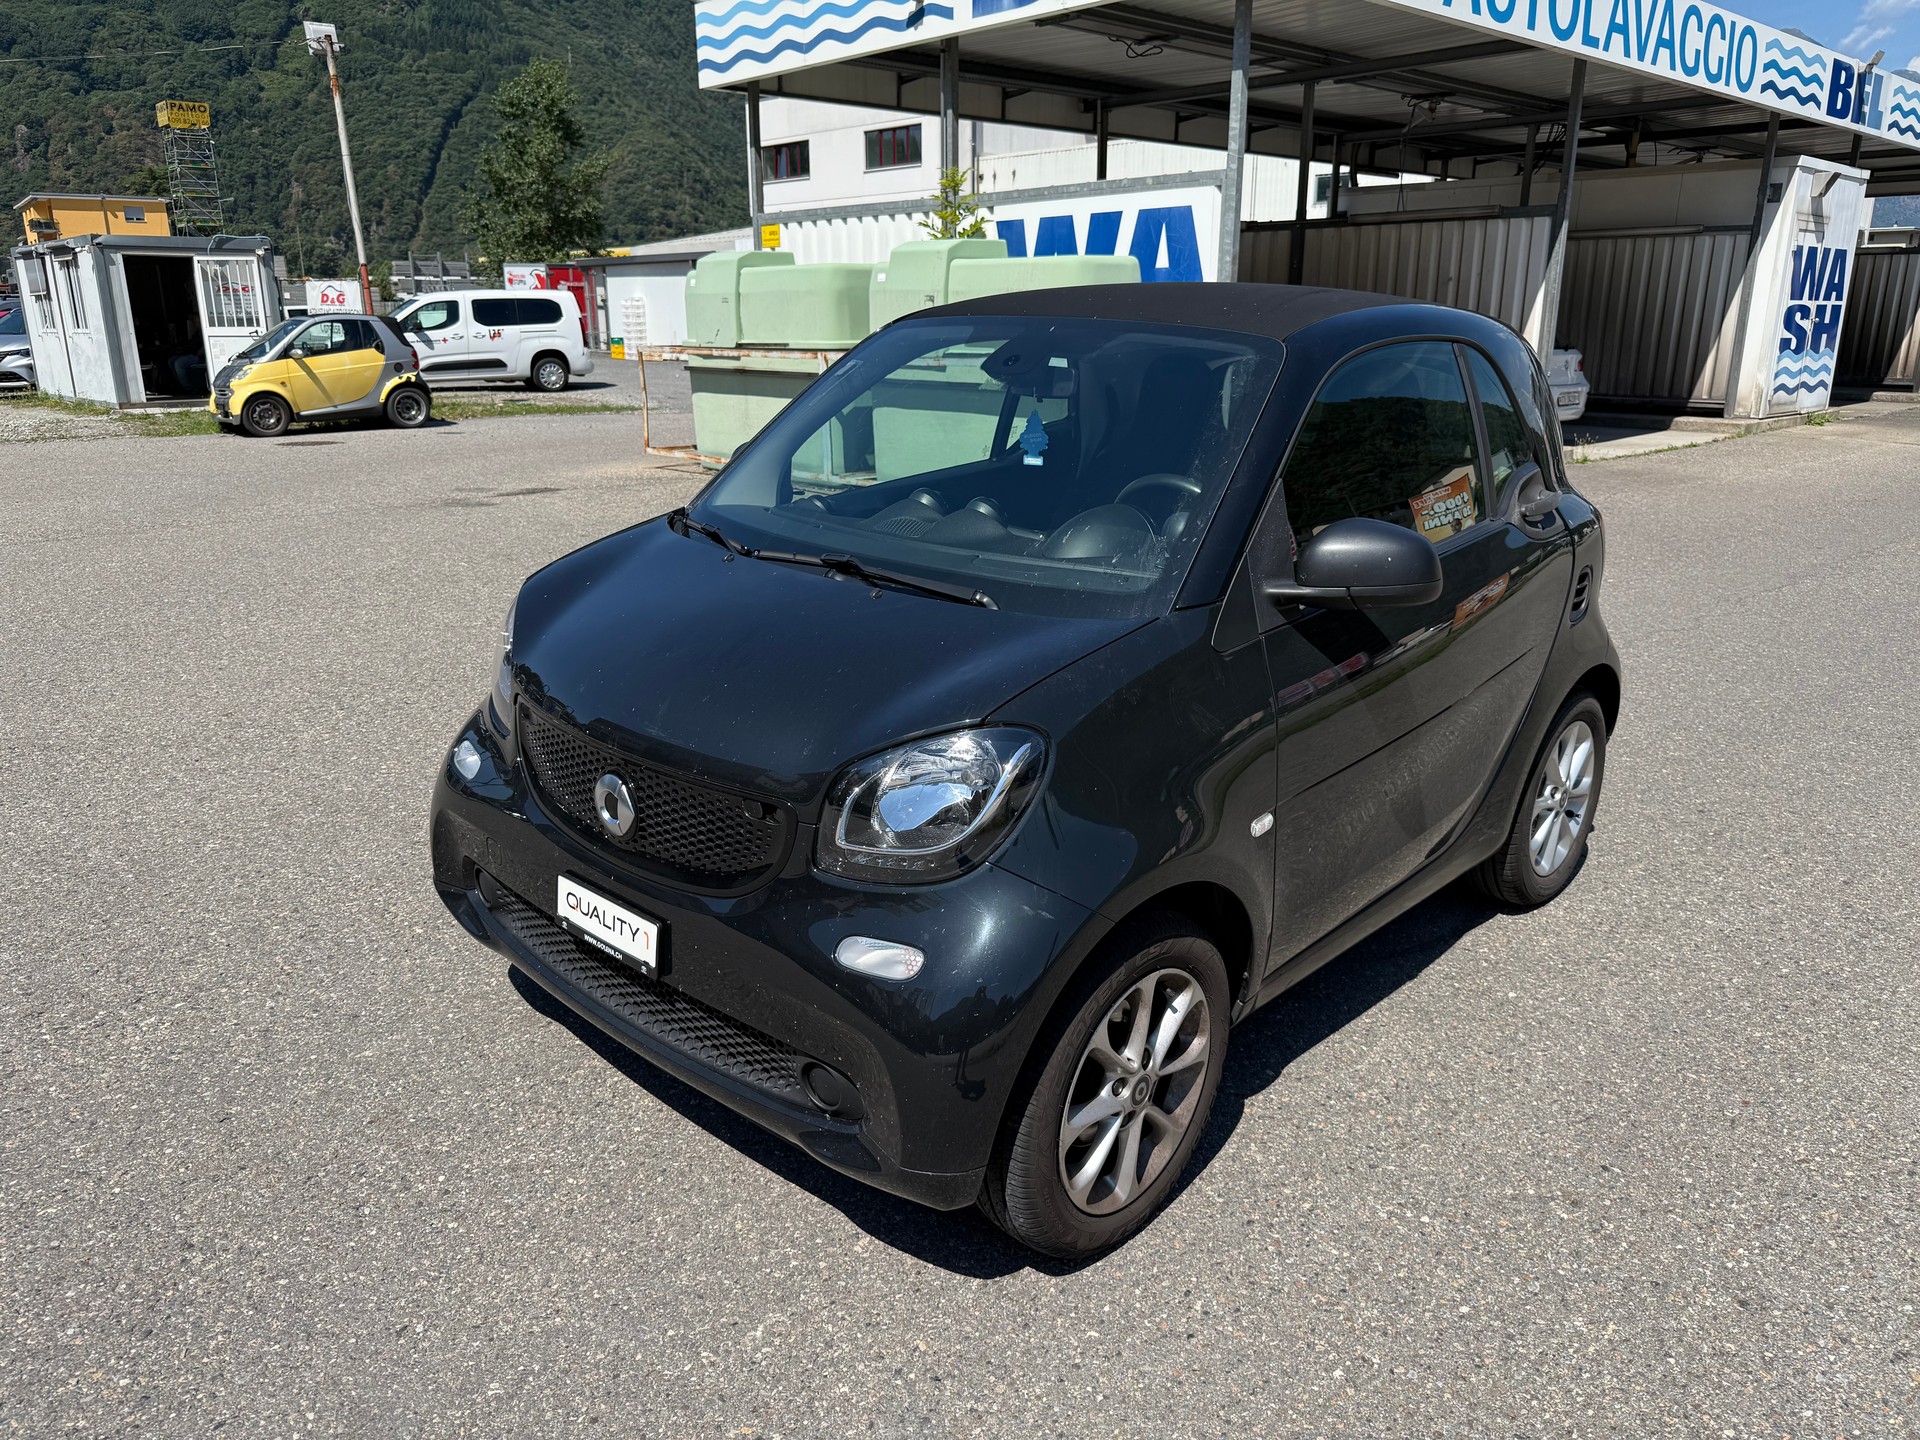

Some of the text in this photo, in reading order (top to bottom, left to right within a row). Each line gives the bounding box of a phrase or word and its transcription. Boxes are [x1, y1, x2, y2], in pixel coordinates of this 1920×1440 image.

[170, 102, 207, 113] PAMO
[1826, 57, 1884, 130] BEL
[321, 293, 346, 304] D&G
[1790, 245, 1848, 301] WA
[1779, 304, 1843, 355] SH
